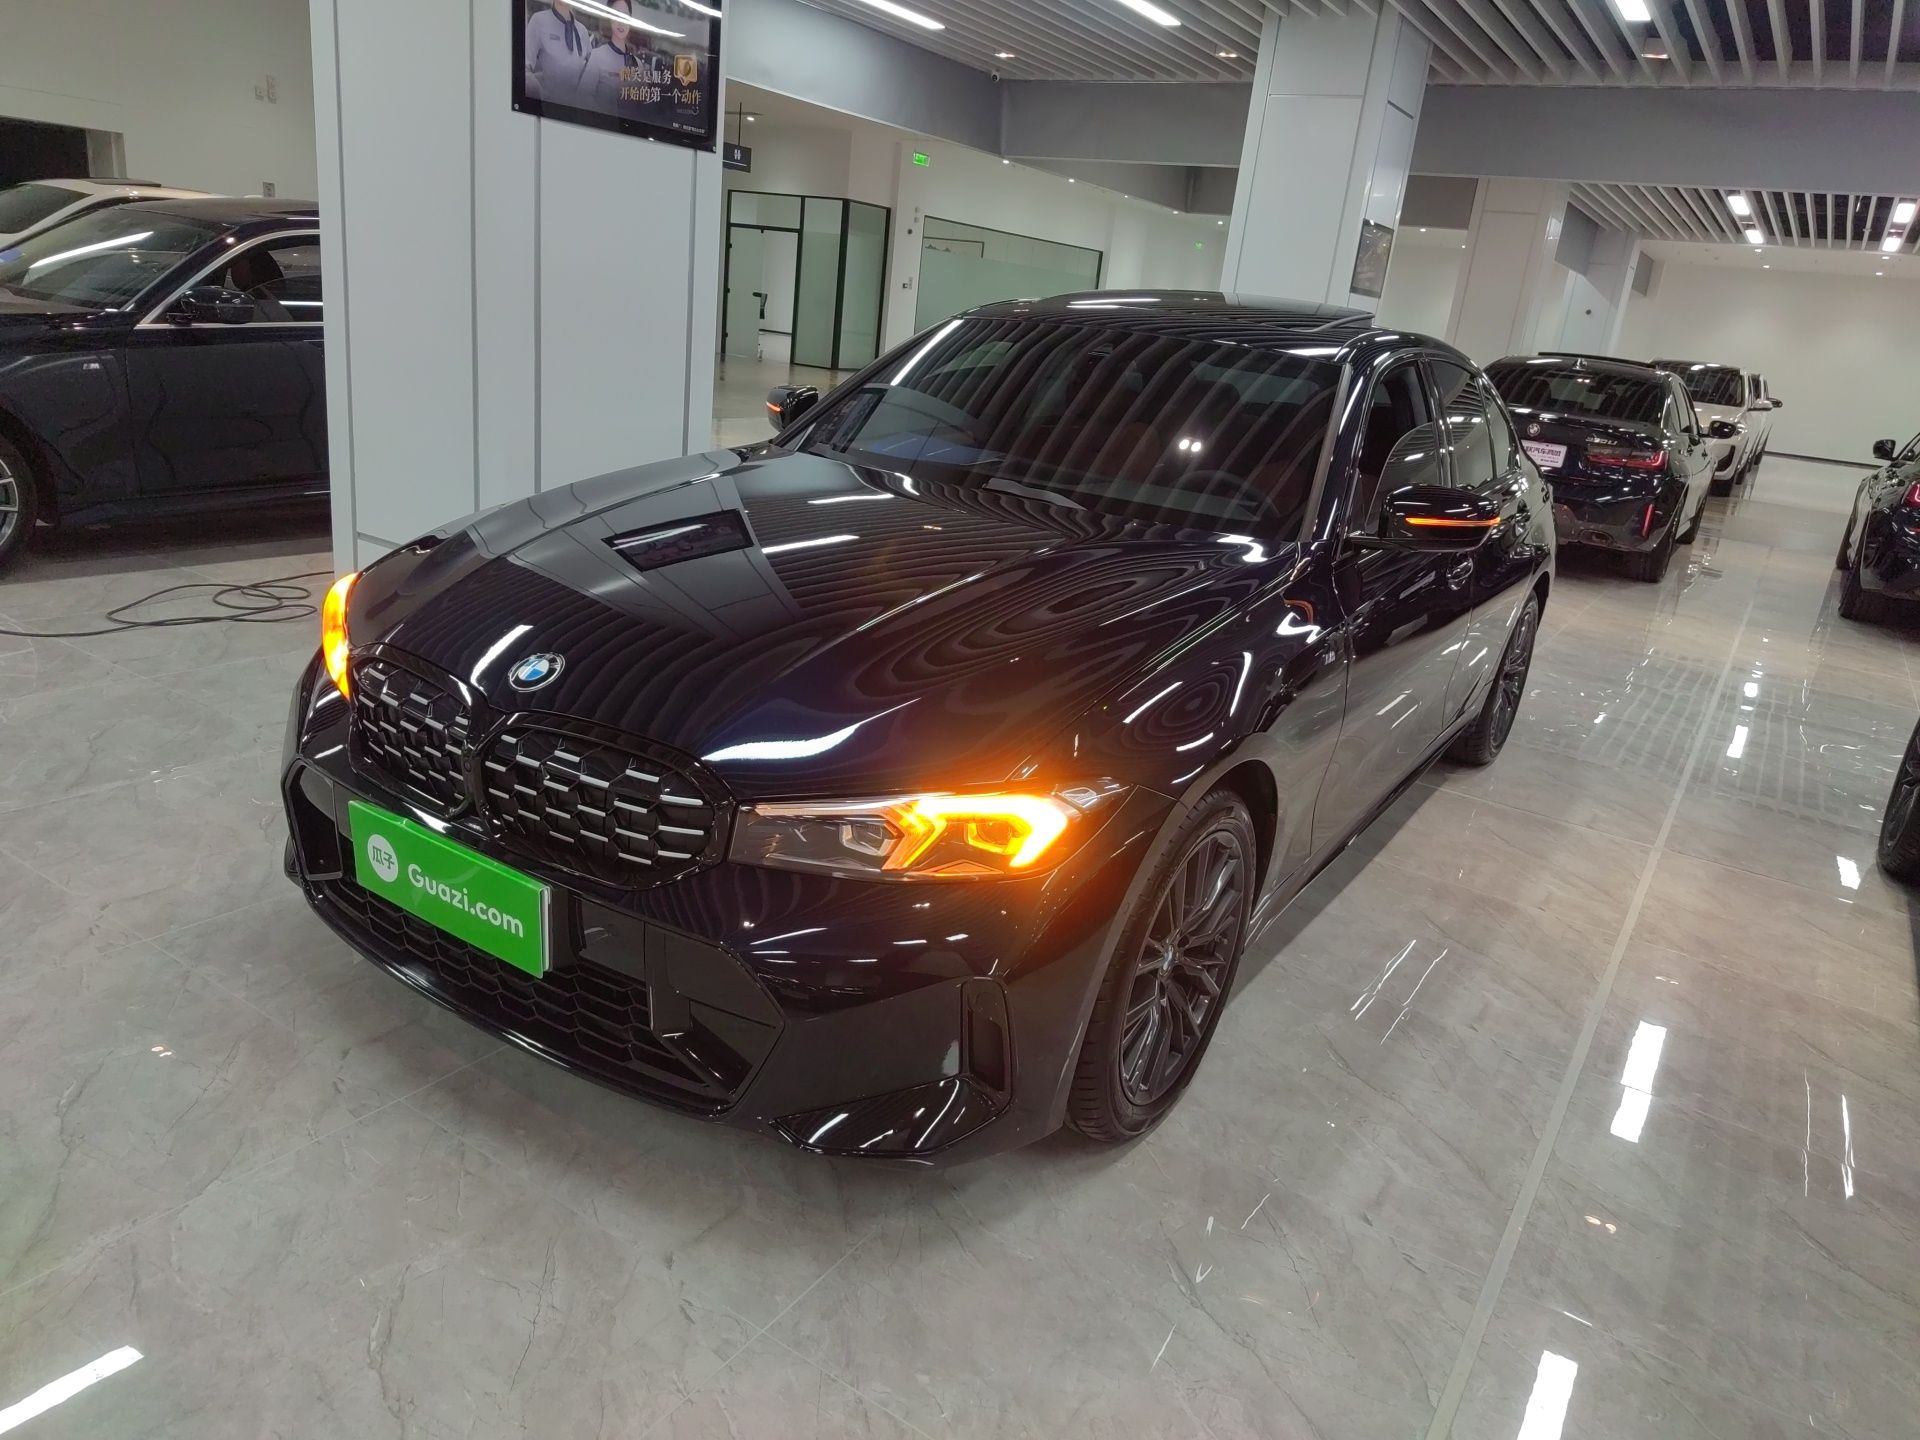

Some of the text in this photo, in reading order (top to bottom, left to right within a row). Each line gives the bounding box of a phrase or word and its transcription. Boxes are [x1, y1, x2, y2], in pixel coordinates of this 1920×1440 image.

[619, 86, 702, 105] 开始的第一个动作
[372, 846, 395, 870] 瓜子
[407, 863, 524, 938] Guazi.com
